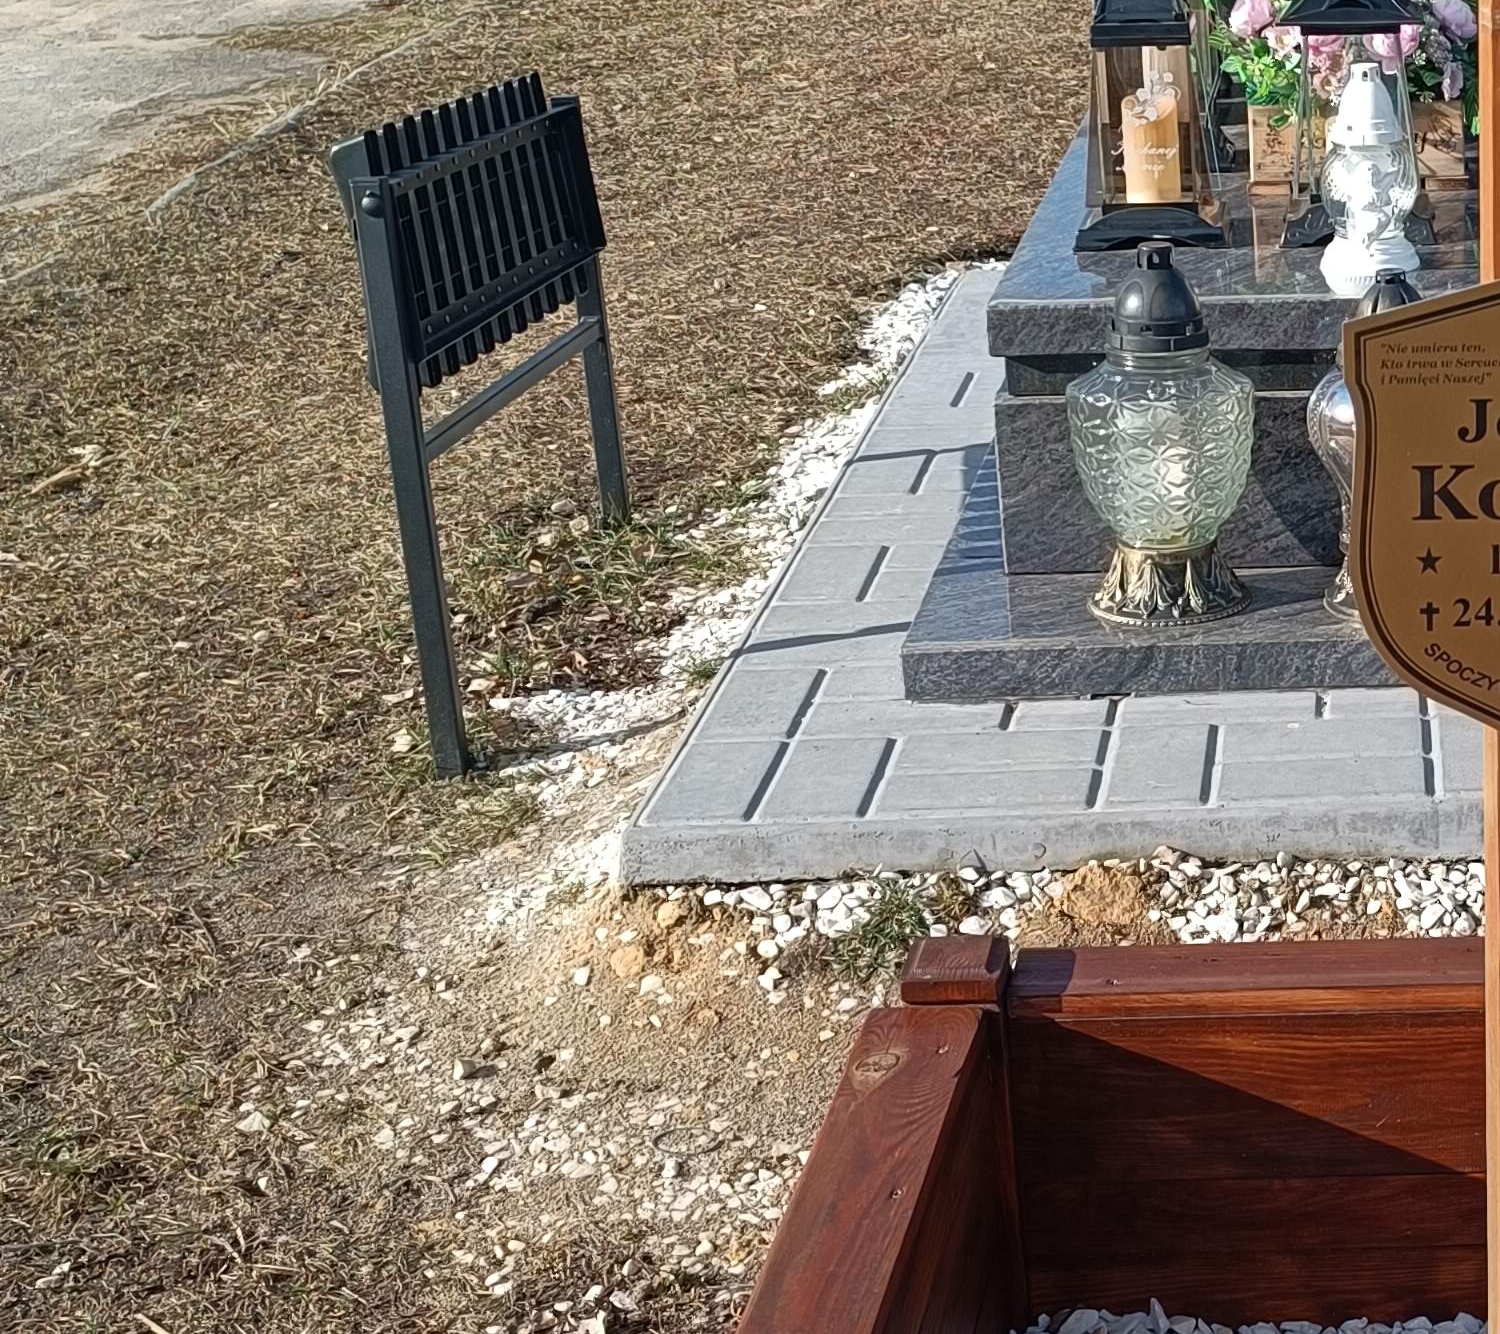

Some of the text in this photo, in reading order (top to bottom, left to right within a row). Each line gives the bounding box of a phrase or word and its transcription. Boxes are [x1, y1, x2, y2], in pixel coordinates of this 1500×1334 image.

[1411, 342, 1458, 354] umiera
[1380, 359, 1404, 370] Kto
[1407, 358, 1438, 369] trwa
[1441, 359, 1453, 369] w
[1388, 372, 1440, 387] Pamięci
